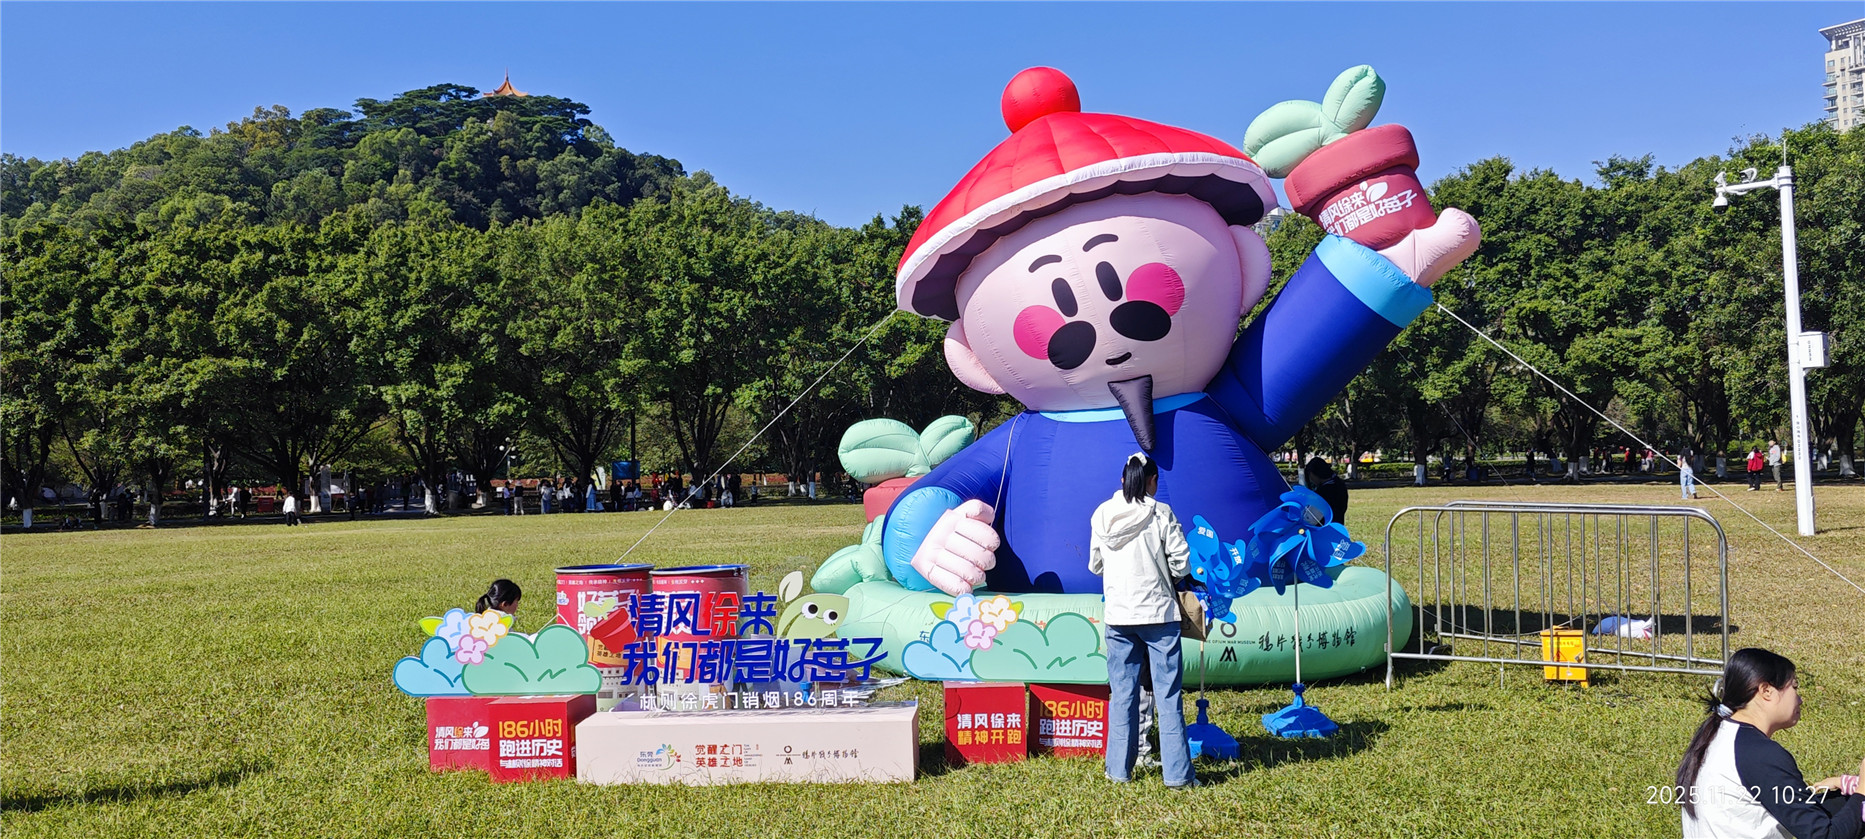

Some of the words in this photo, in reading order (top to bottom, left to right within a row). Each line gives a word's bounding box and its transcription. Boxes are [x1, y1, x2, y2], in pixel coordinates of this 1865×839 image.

[1319, 191, 1366, 228] 清风徐来
[628, 591, 777, 637] 清风徐来
[621, 637, 888, 686] 我们都是好苗子
[639, 690, 860, 711] 林则徐虎门销烟186周年
[1039, 700, 1104, 719] 186小时
[498, 718, 562, 738] 186小时
[957, 713, 1021, 729] 清风徐来
[1039, 718, 1103, 737] 跑进历史
[434, 726, 473, 738] 清风徐来
[957, 729, 1021, 745] 精神开跑
[499, 739, 563, 757] 跑进历史
[695, 744, 742, 755] 觉醒之门
[696, 756, 743, 767] 英雄之地
